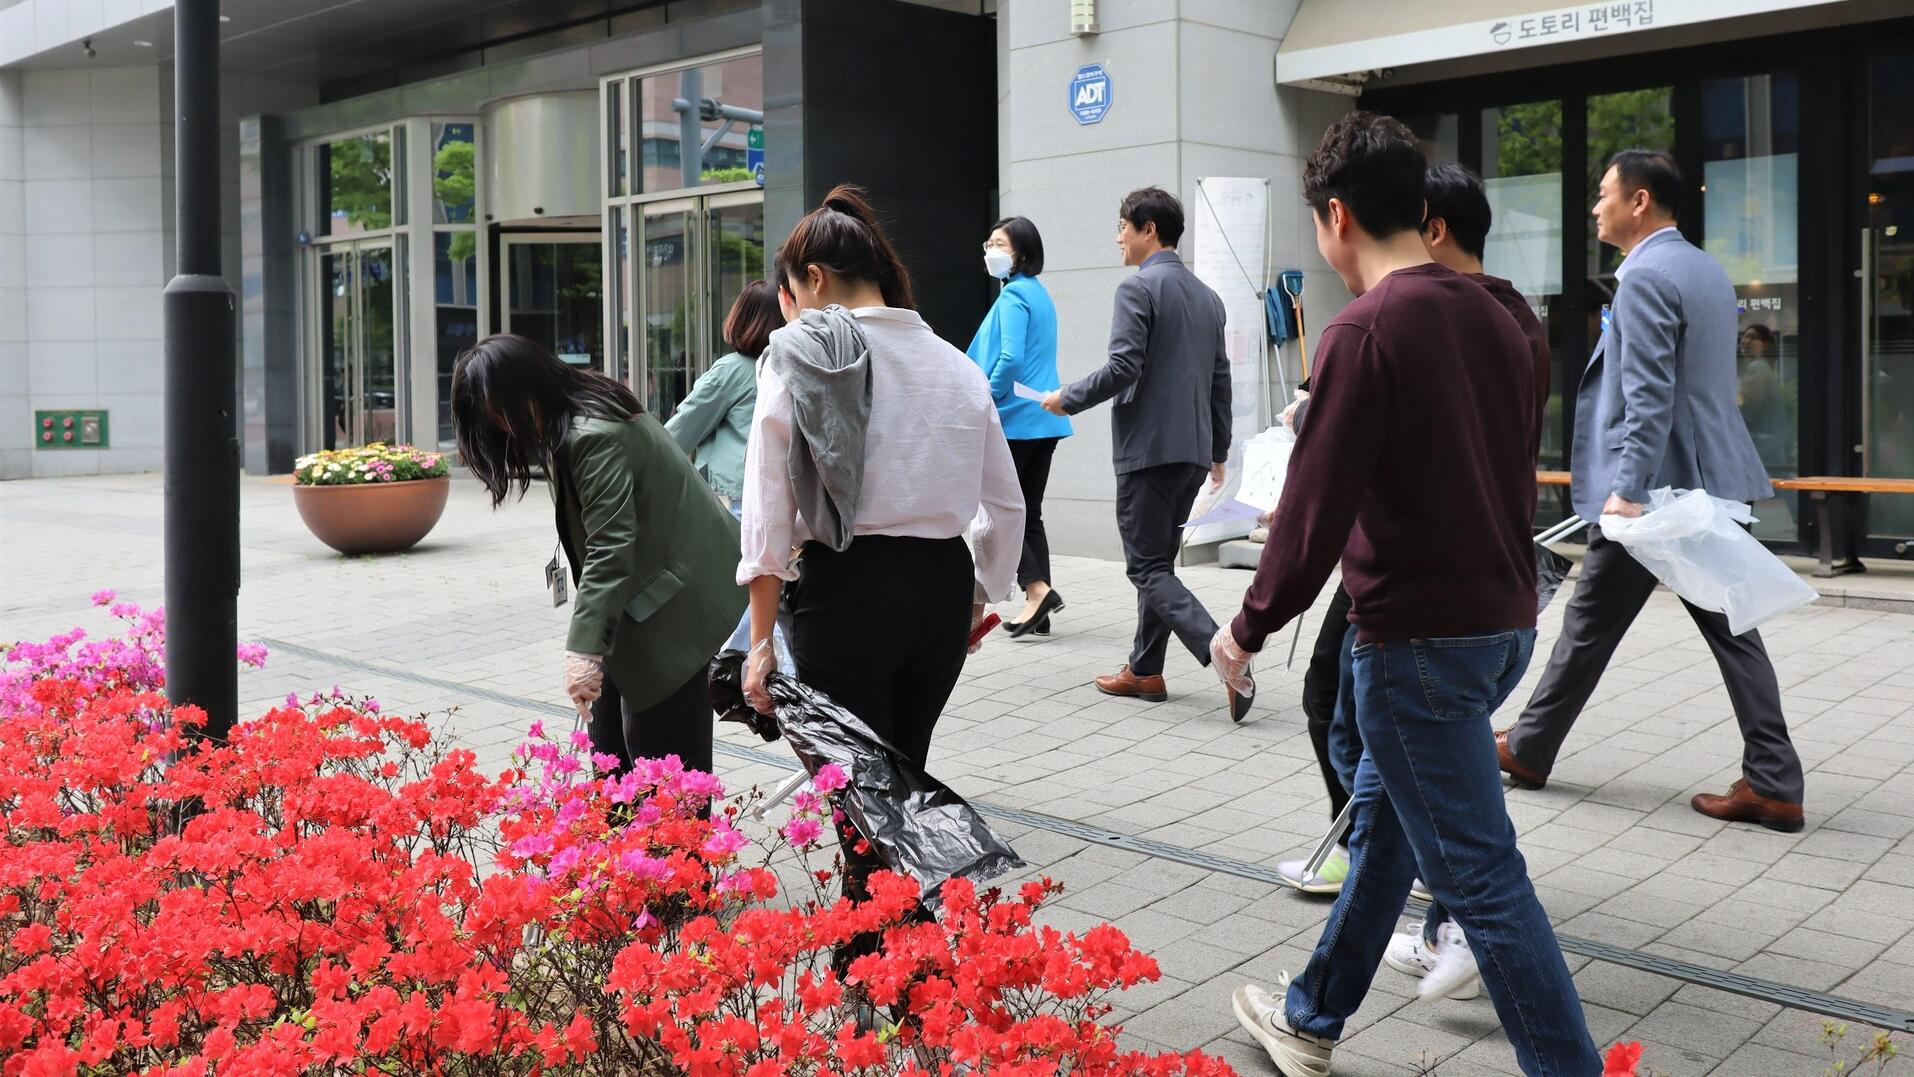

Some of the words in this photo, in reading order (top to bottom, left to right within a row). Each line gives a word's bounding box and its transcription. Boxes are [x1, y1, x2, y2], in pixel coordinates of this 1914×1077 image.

[1518, 11, 1580, 40] 도토리
[1588, 1, 1654, 32] 편백집
[1076, 81, 1105, 106] ADT
[1749, 297, 1782, 310] 편백집
